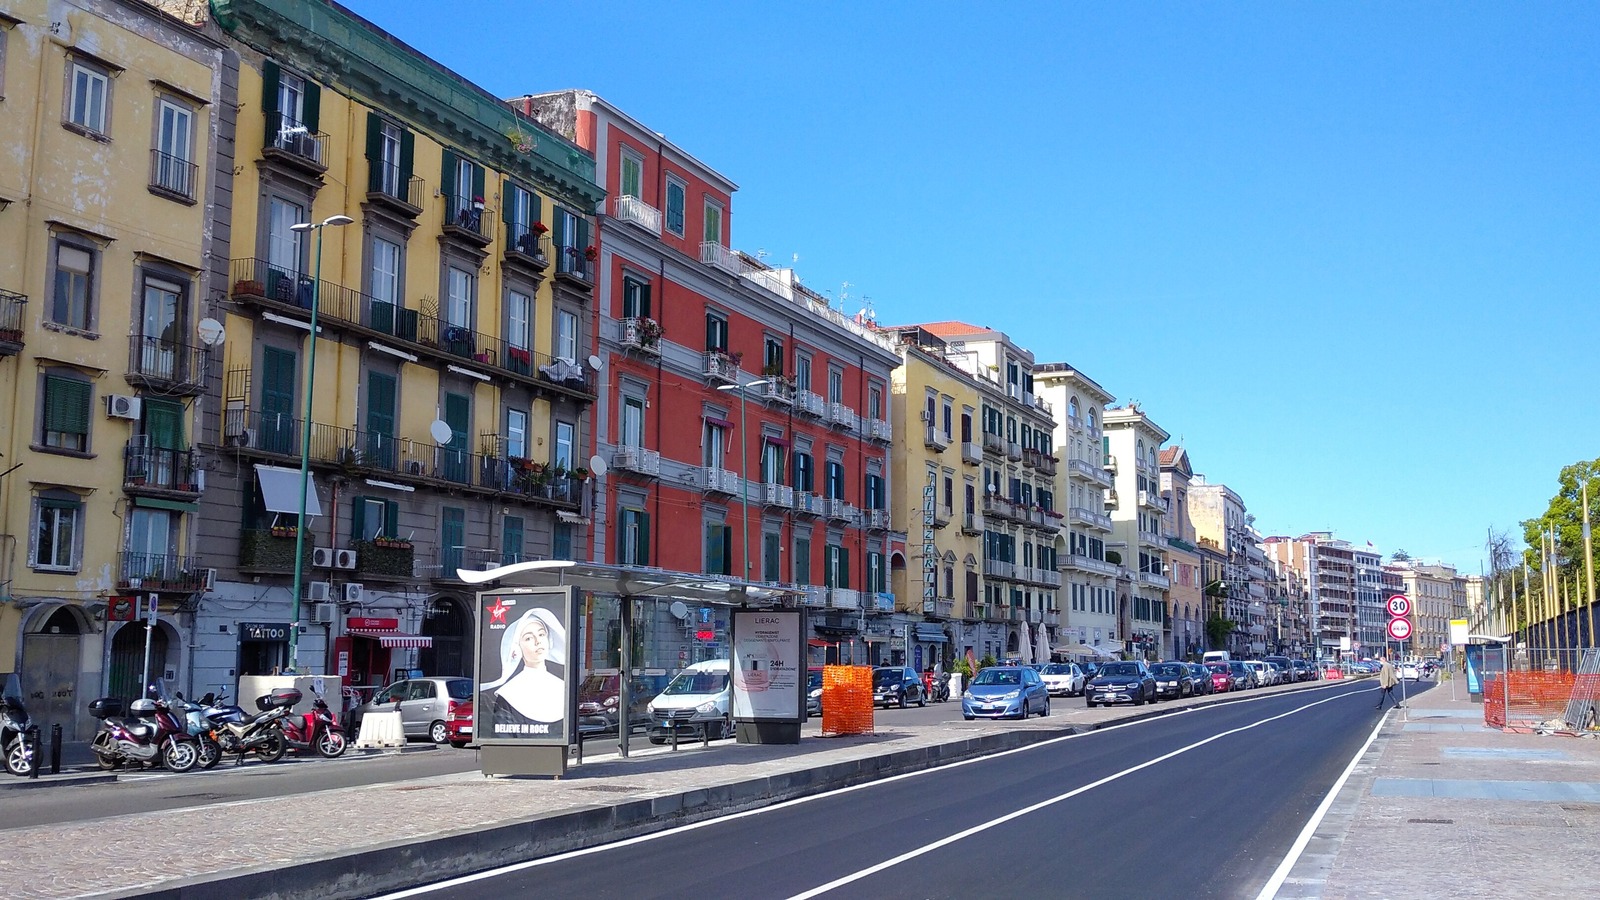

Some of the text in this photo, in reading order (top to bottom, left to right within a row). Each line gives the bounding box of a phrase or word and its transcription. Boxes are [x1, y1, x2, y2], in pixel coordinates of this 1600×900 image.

[924, 487, 934, 597] PIZZERIA
[1392, 601, 1406, 611] 30
[249, 628, 285, 639] TATTOO
[494, 723, 550, 734] BELIEVE IN ROCK
